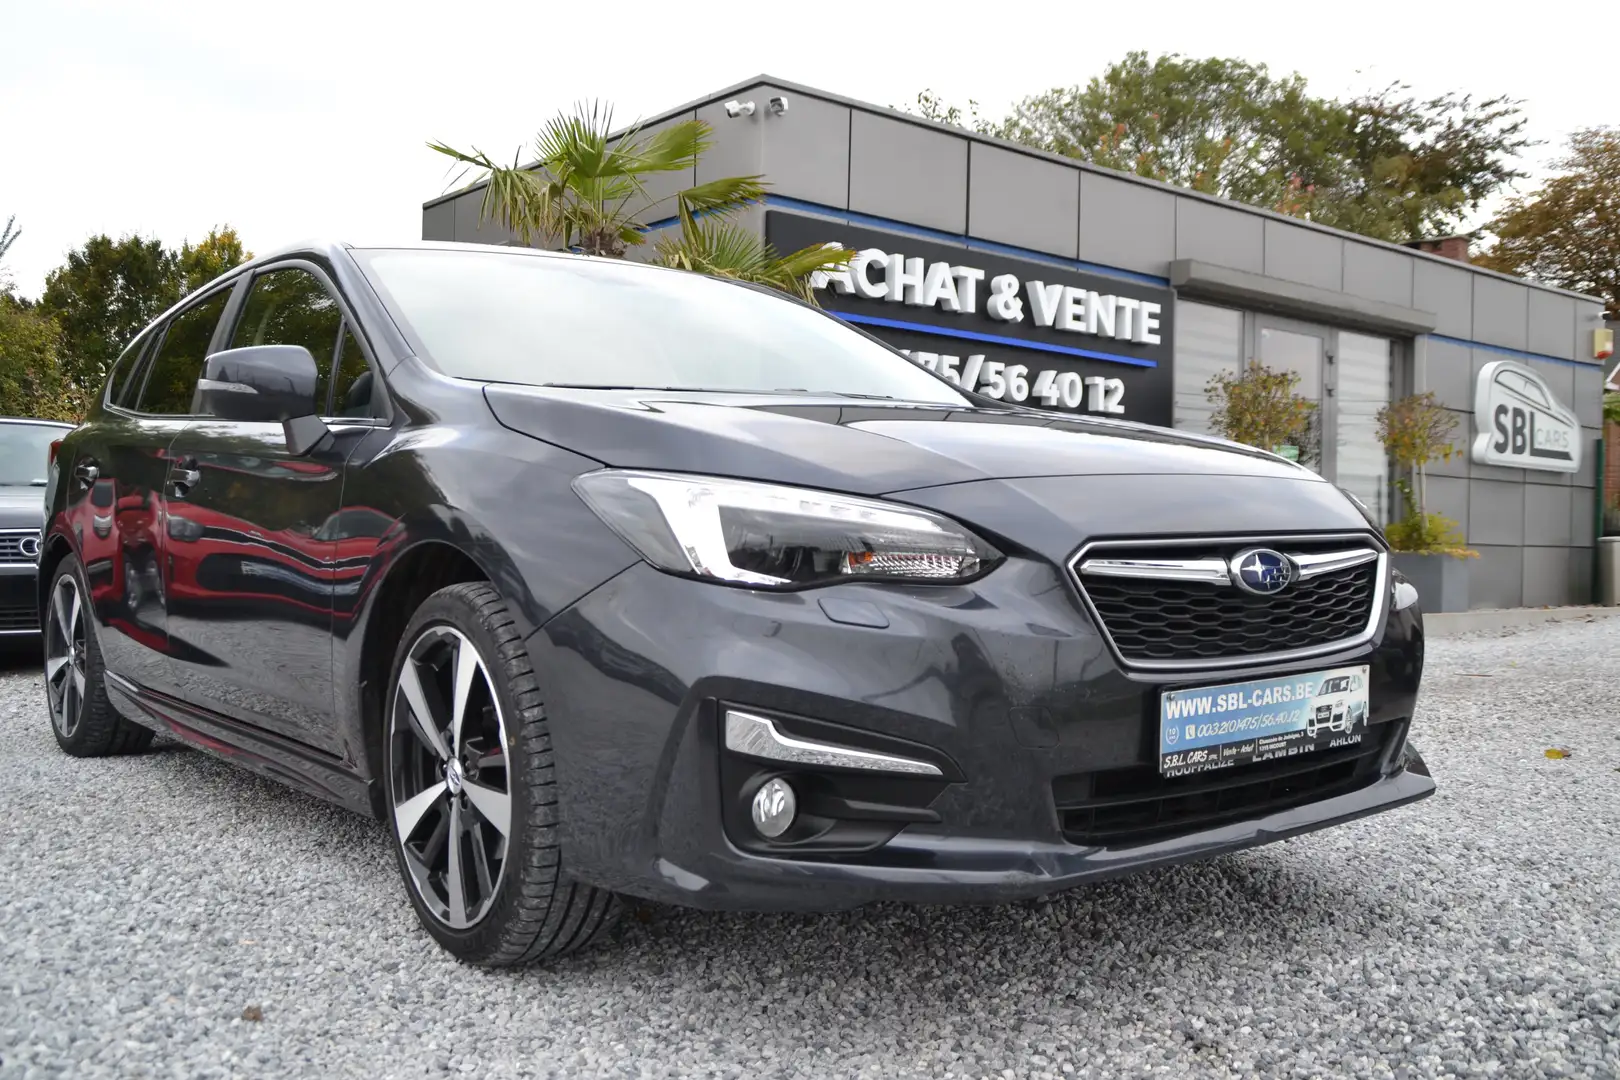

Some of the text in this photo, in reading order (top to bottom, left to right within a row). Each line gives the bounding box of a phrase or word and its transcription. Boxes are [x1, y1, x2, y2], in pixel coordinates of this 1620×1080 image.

[811, 241, 1162, 344] ACHAT & VENTE
[900, 349, 1125, 414] 75/56 40 12
[1494, 404, 1574, 461] SBL CARS
[1166, 682, 1314, 719] WWW.SBL-CARS.BE
[1164, 753, 1186, 768] S.B.L.
[1187, 750, 1208, 764] CARS
